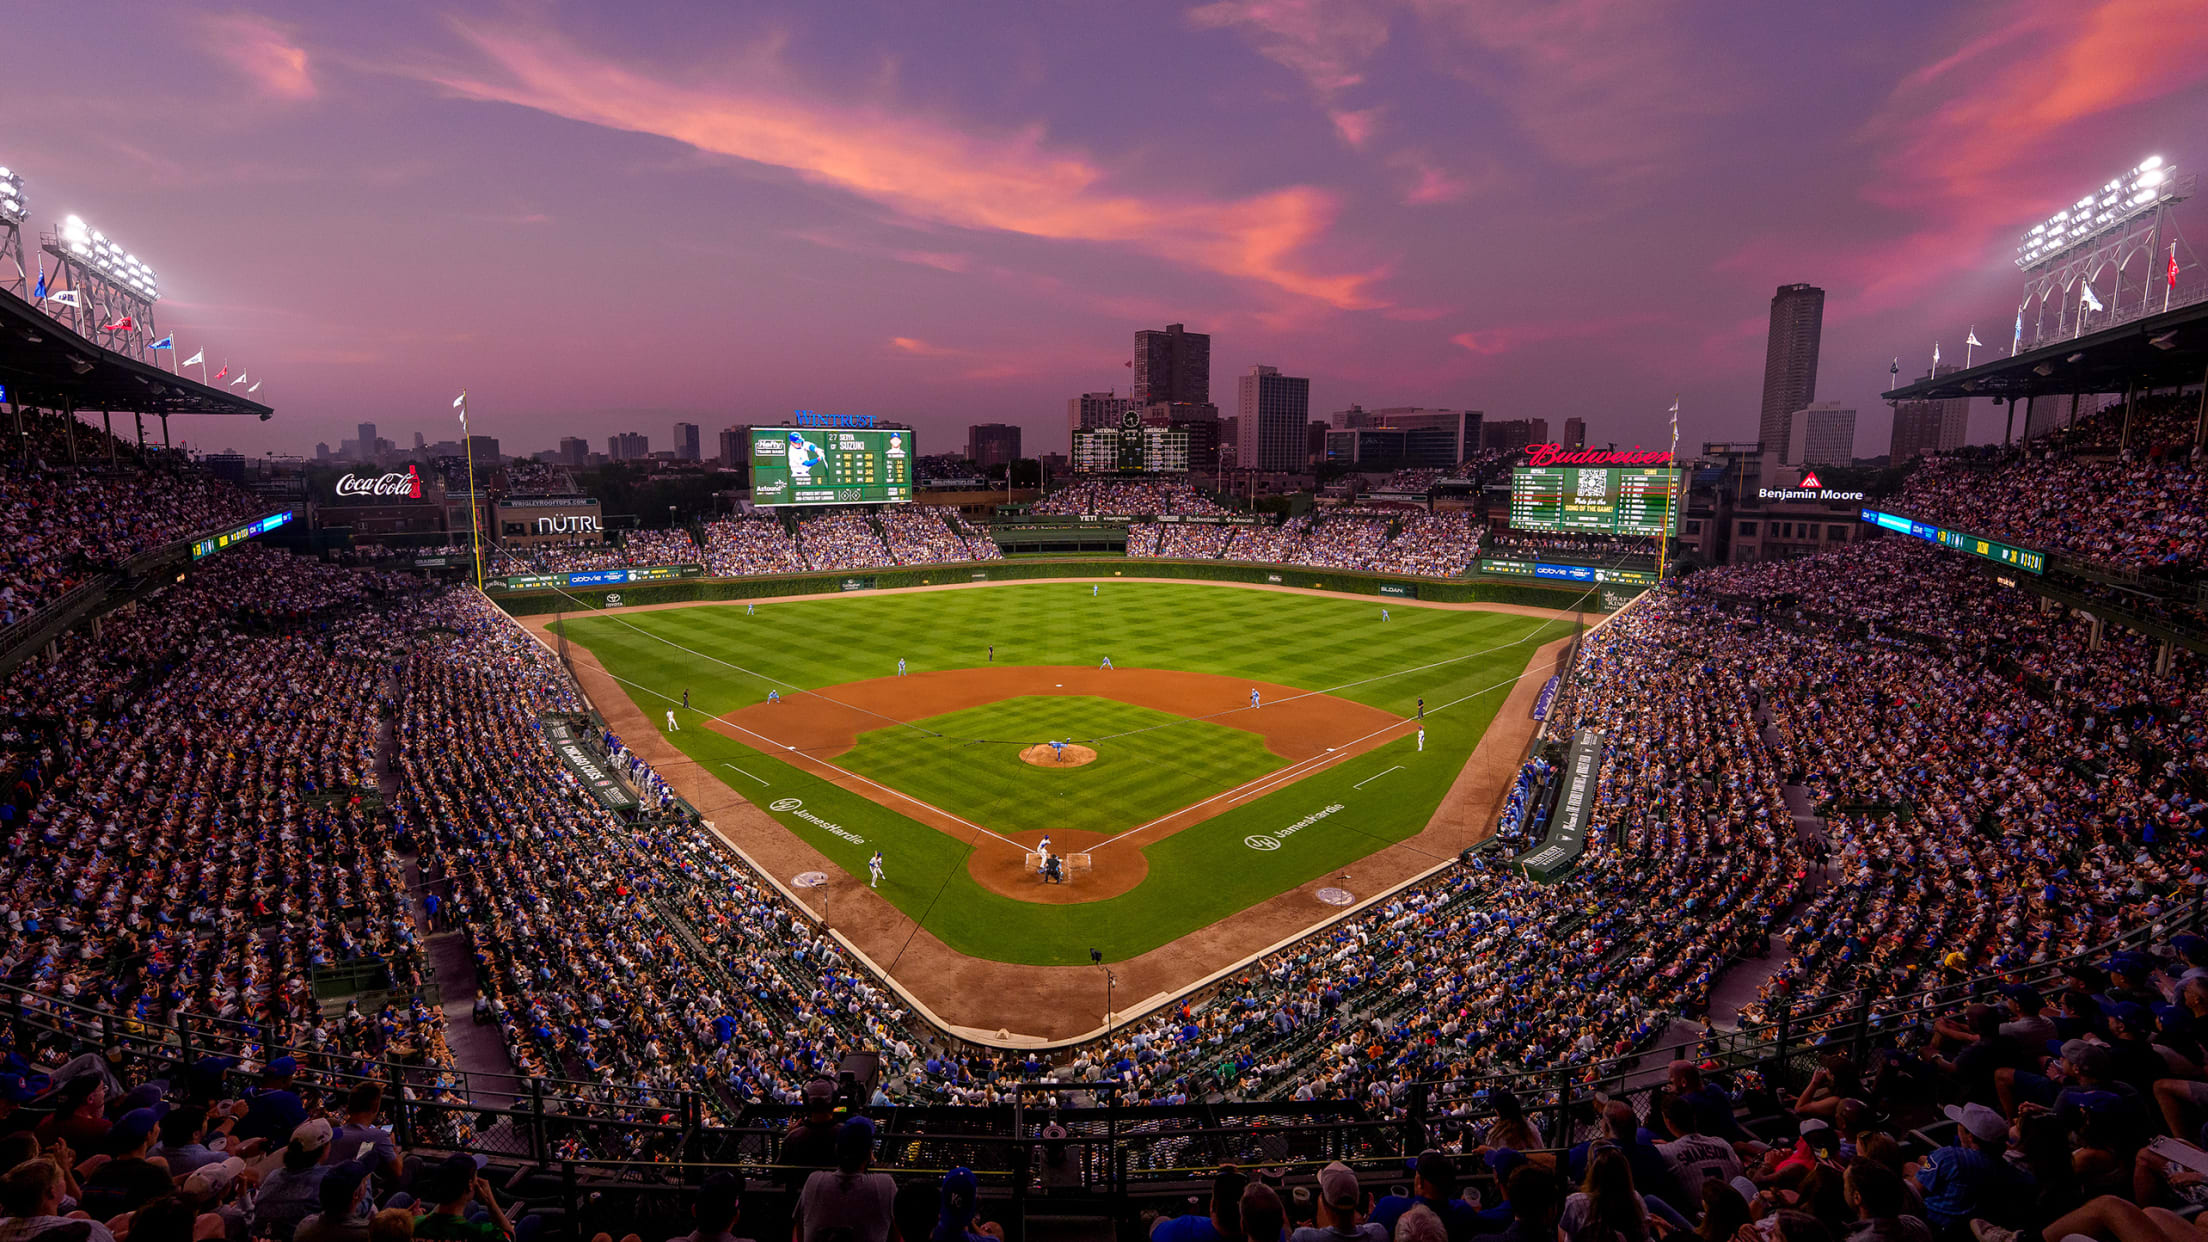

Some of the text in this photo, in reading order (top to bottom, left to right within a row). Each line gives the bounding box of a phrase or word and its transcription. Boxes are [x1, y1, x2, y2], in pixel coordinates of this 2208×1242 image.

[839, 441, 865, 450] SUZUKI
[1524, 443, 1675, 467] Budweiser
[335, 473, 413, 496] Coca-Cola
[1759, 488, 1864, 500] Benjamin Moore
[571, 575, 602, 583] abbvie
[1536, 567, 1567, 576] abbvie
[582, 763, 604, 781] CUBS
[793, 809, 864, 845] JamesHardie
[1274, 802, 1345, 838] JamesHardie
[1677, 1144, 1730, 1166] SWANSON
